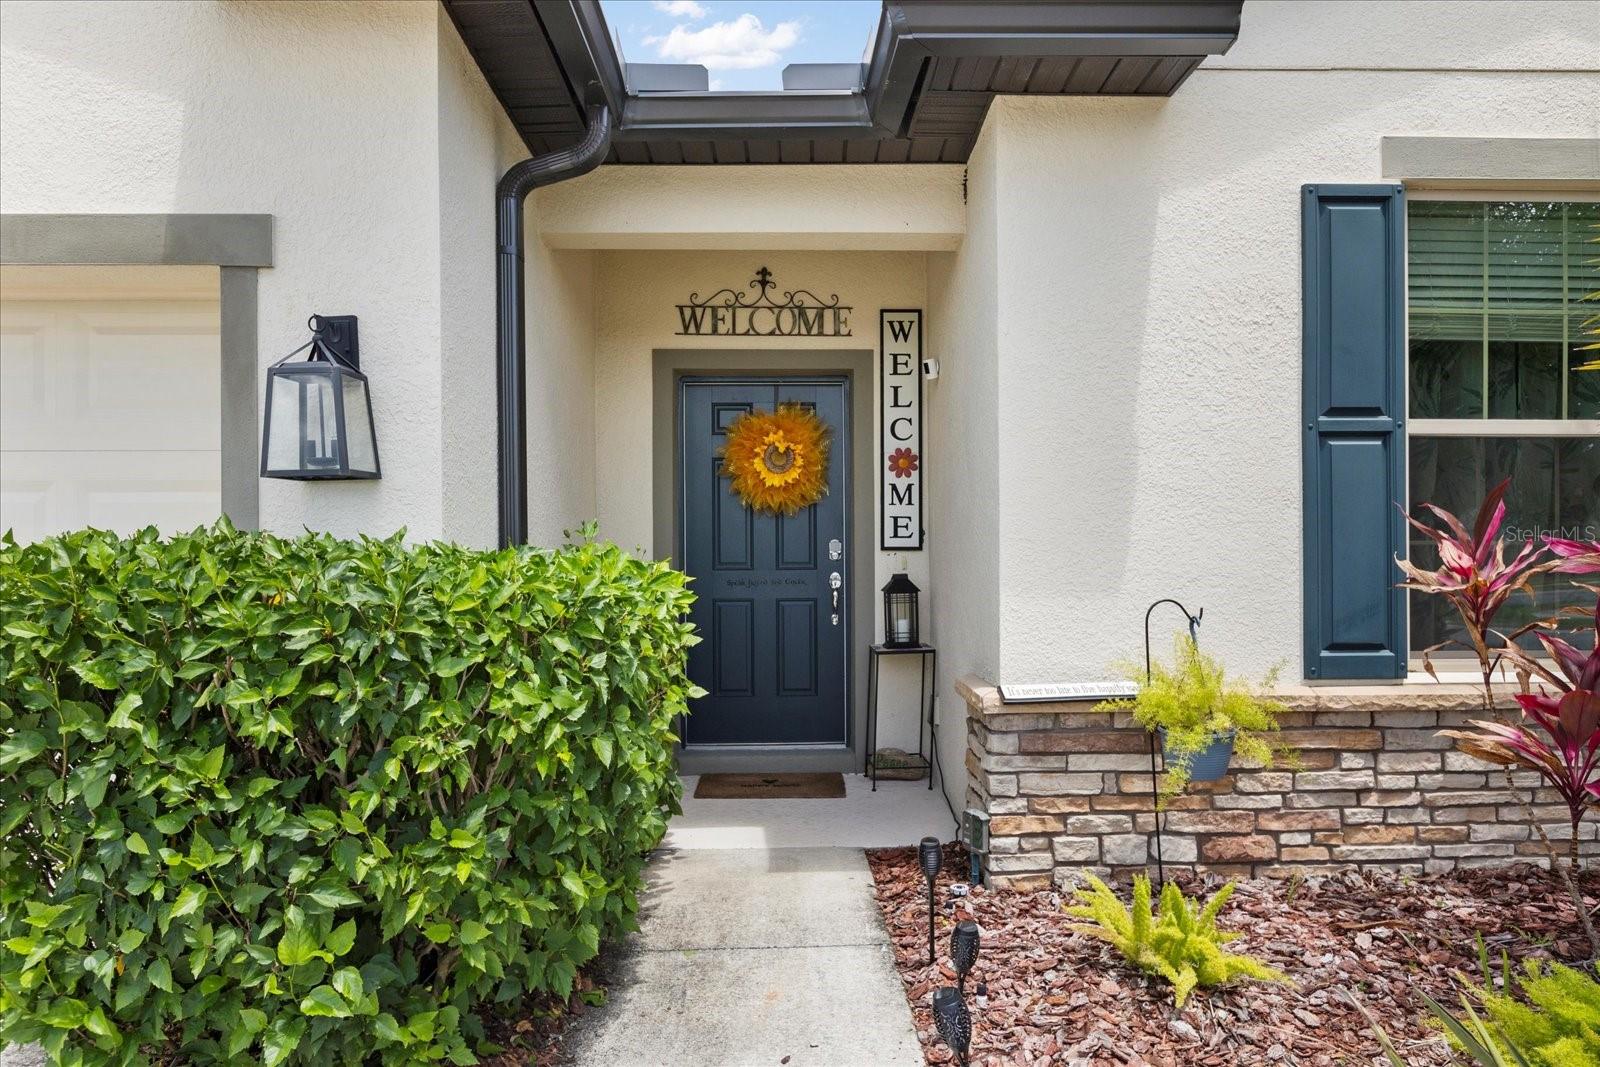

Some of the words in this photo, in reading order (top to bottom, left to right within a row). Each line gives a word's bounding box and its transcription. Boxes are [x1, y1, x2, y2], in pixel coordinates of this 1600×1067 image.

[677, 306, 852, 336] WELCOME
[886, 320, 918, 540] WELCME
[1022, 688, 1043, 696] never
